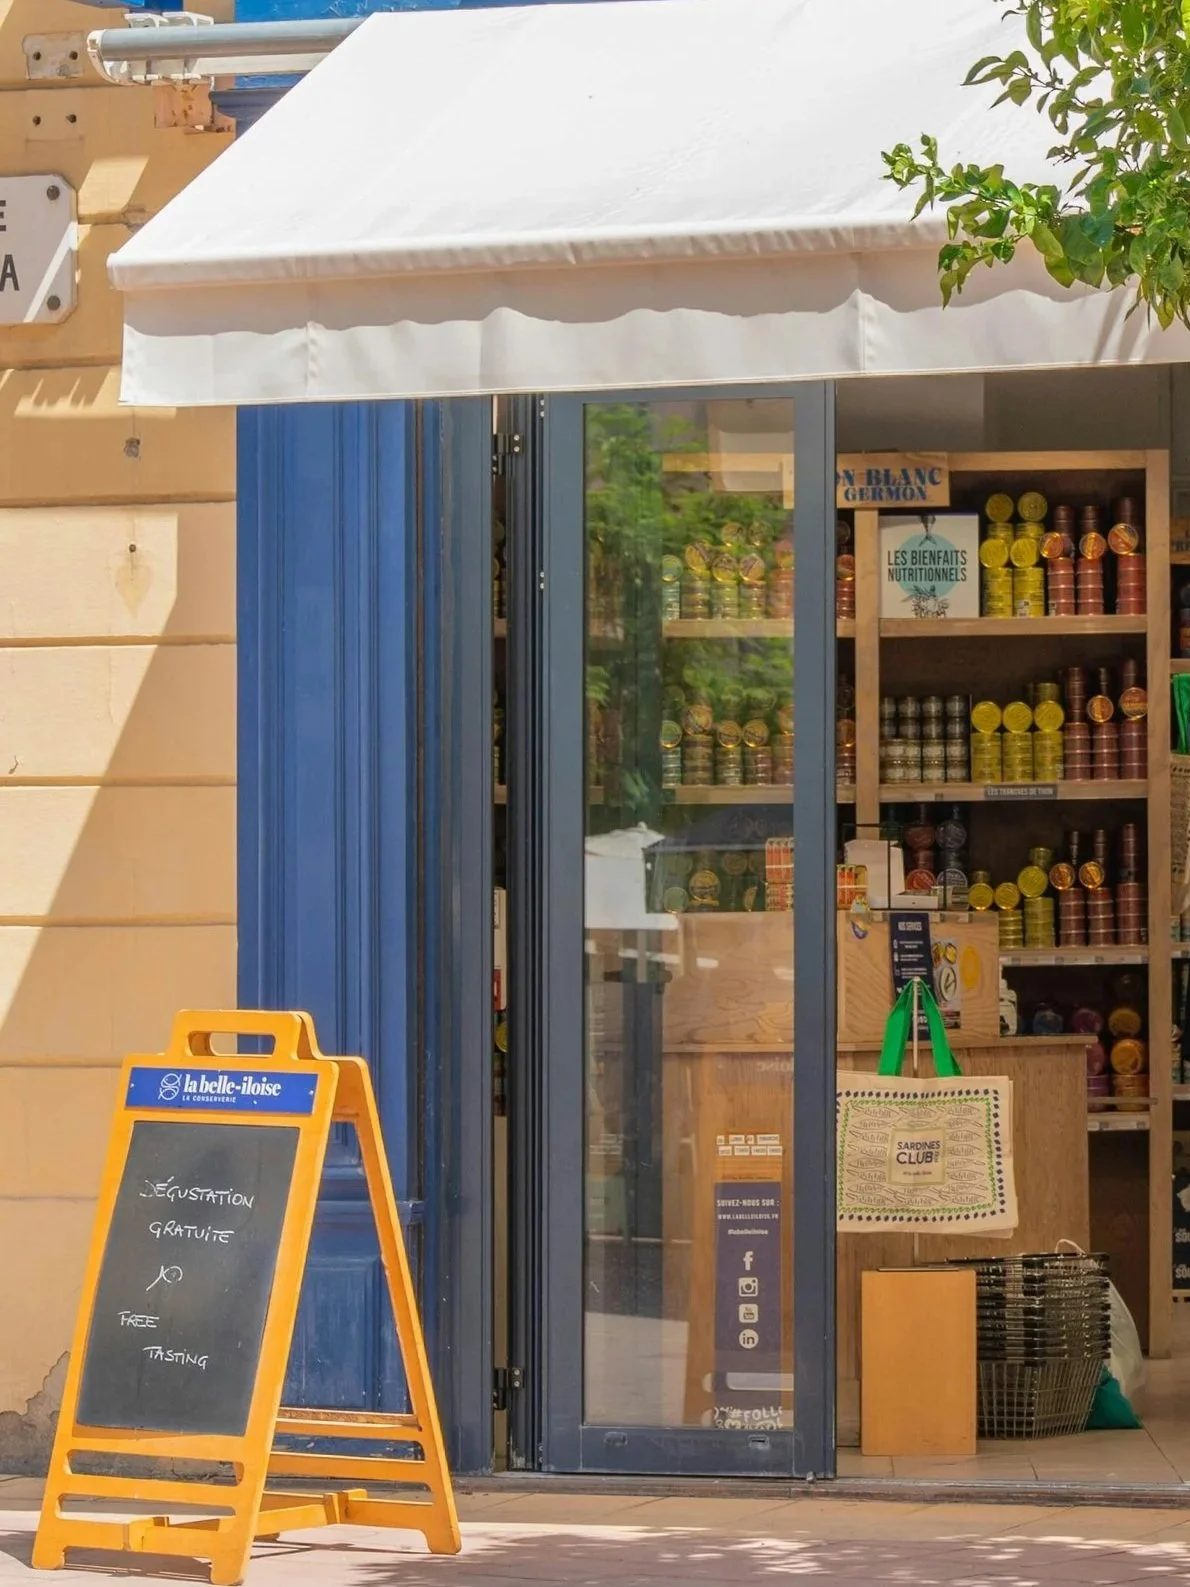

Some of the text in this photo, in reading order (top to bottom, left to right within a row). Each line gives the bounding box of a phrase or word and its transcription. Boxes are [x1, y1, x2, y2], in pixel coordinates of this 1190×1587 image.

[865, 468, 943, 487] BLANC
[844, 486, 928, 502] GERMON
[887, 550, 968, 566] LES BIENFAITS
[887, 567, 968, 582] NUTRITIONNELS
[184, 1074, 282, 1097] la belle-iloise
[897, 1140, 941, 1151] SARDINES
[896, 1151, 934, 1165] CLUB
[138, 1176, 256, 1209] DÉGUSTATION
[716, 1198, 760, 1208] SUIVEZ-NOUS
[761, 1198, 775, 1207] SUR
[149, 1220, 235, 1244] GRATUITE
[117, 1311, 160, 1328] FREE
[143, 1345, 209, 1370] TASTING
